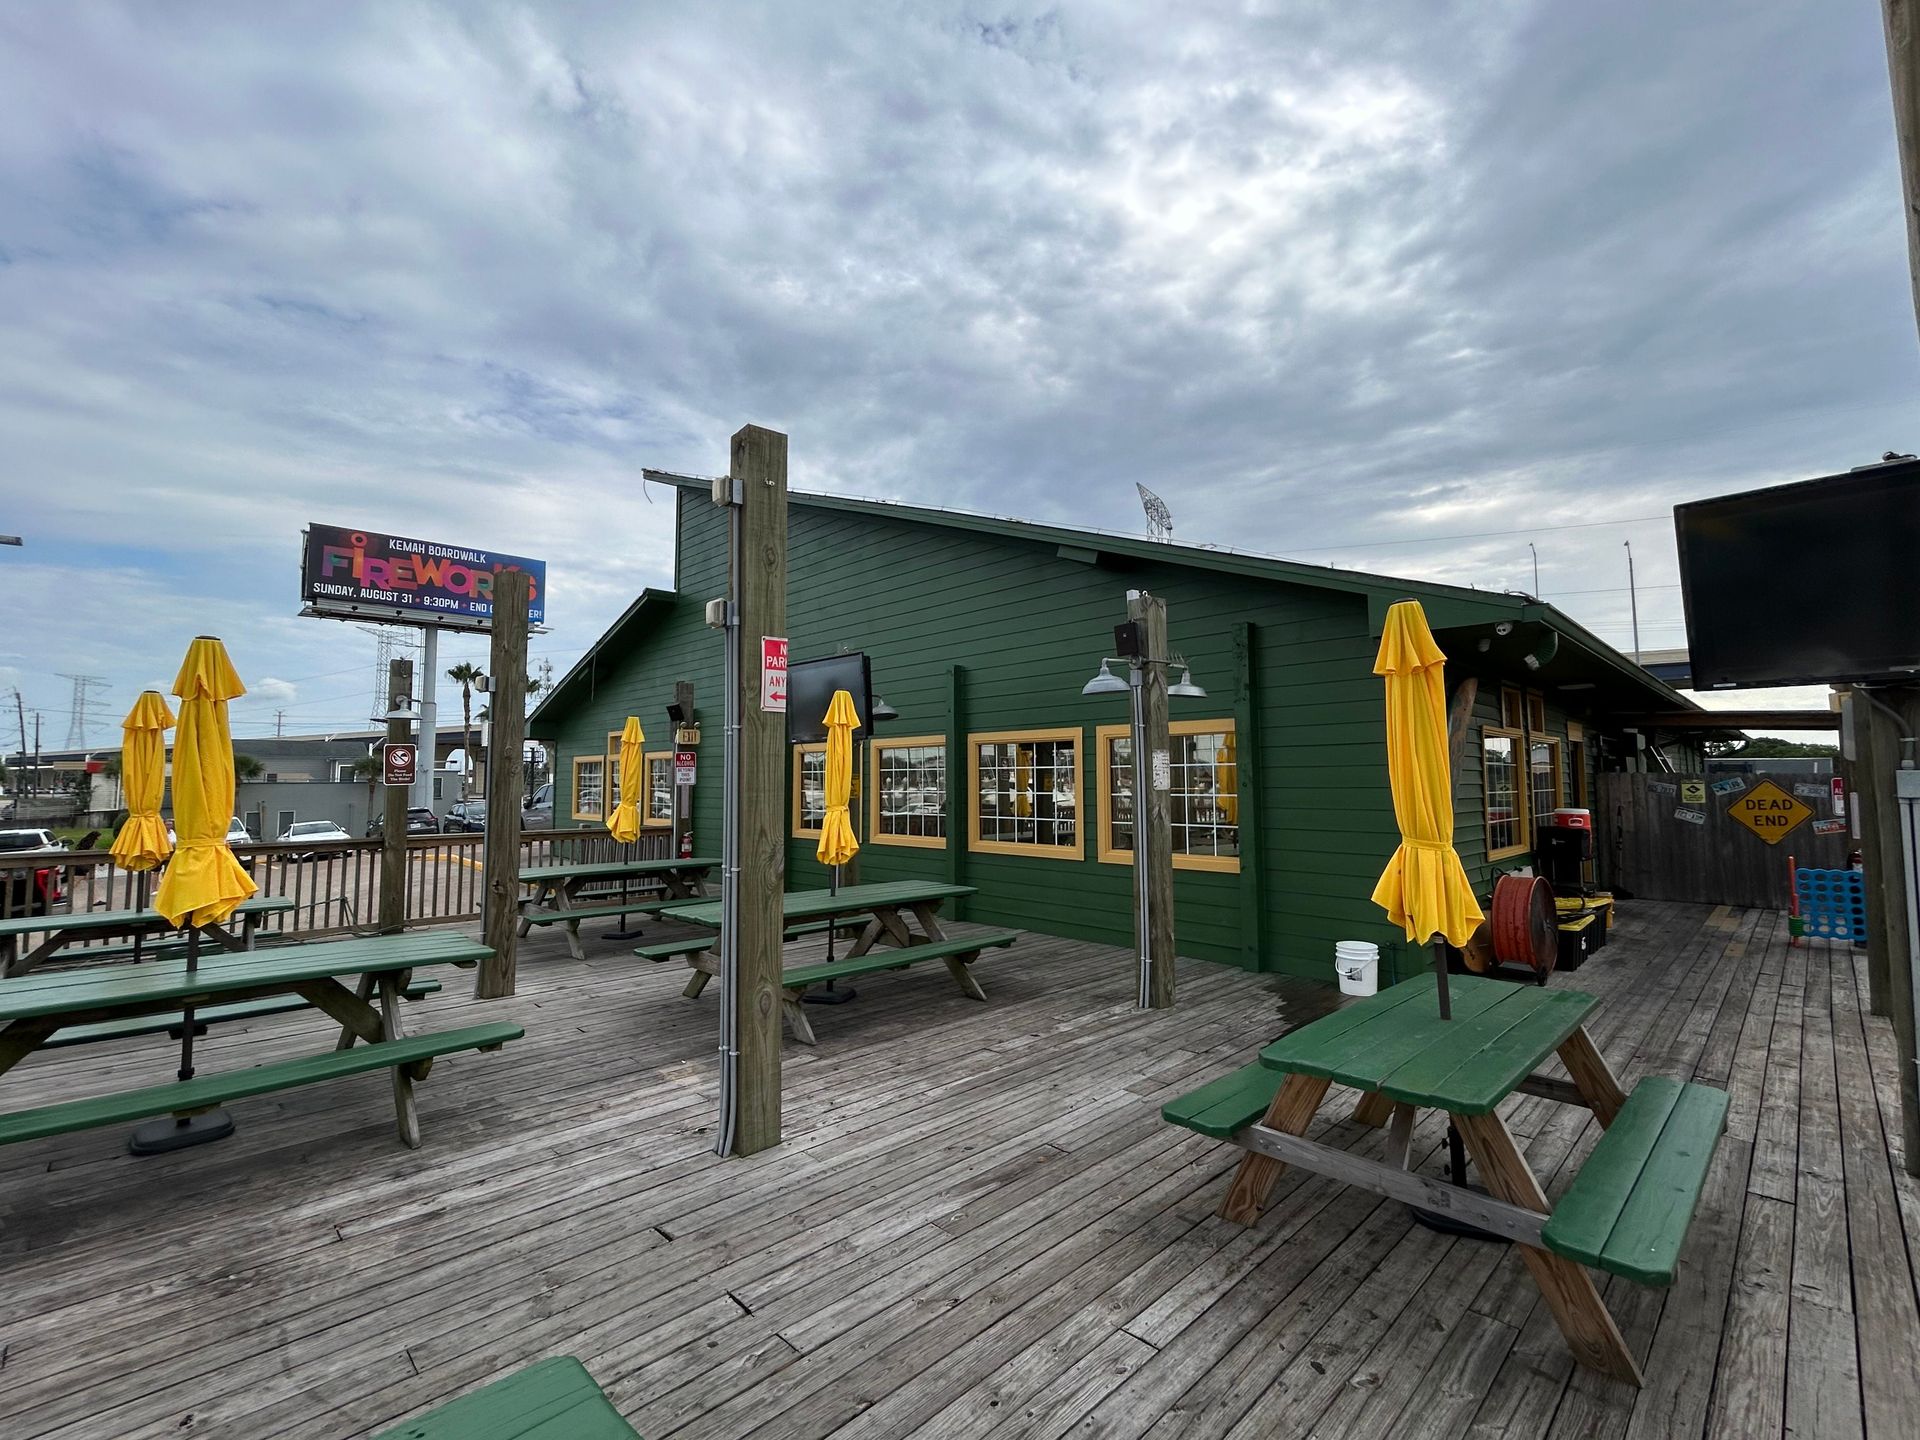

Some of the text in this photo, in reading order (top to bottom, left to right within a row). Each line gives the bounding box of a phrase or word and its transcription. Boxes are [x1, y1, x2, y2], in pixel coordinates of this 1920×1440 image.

[389, 539, 486, 563] KEMAH BOARDWALK
[360, 588, 398, 602] AUGUST
[402, 593, 412, 604] 31
[423, 596, 459, 609] 9:30PM
[470, 602, 487, 613] END
[683, 731, 697, 742] EXIT
[1745, 799, 1793, 810] DEAD
[1754, 815, 1789, 826] END
